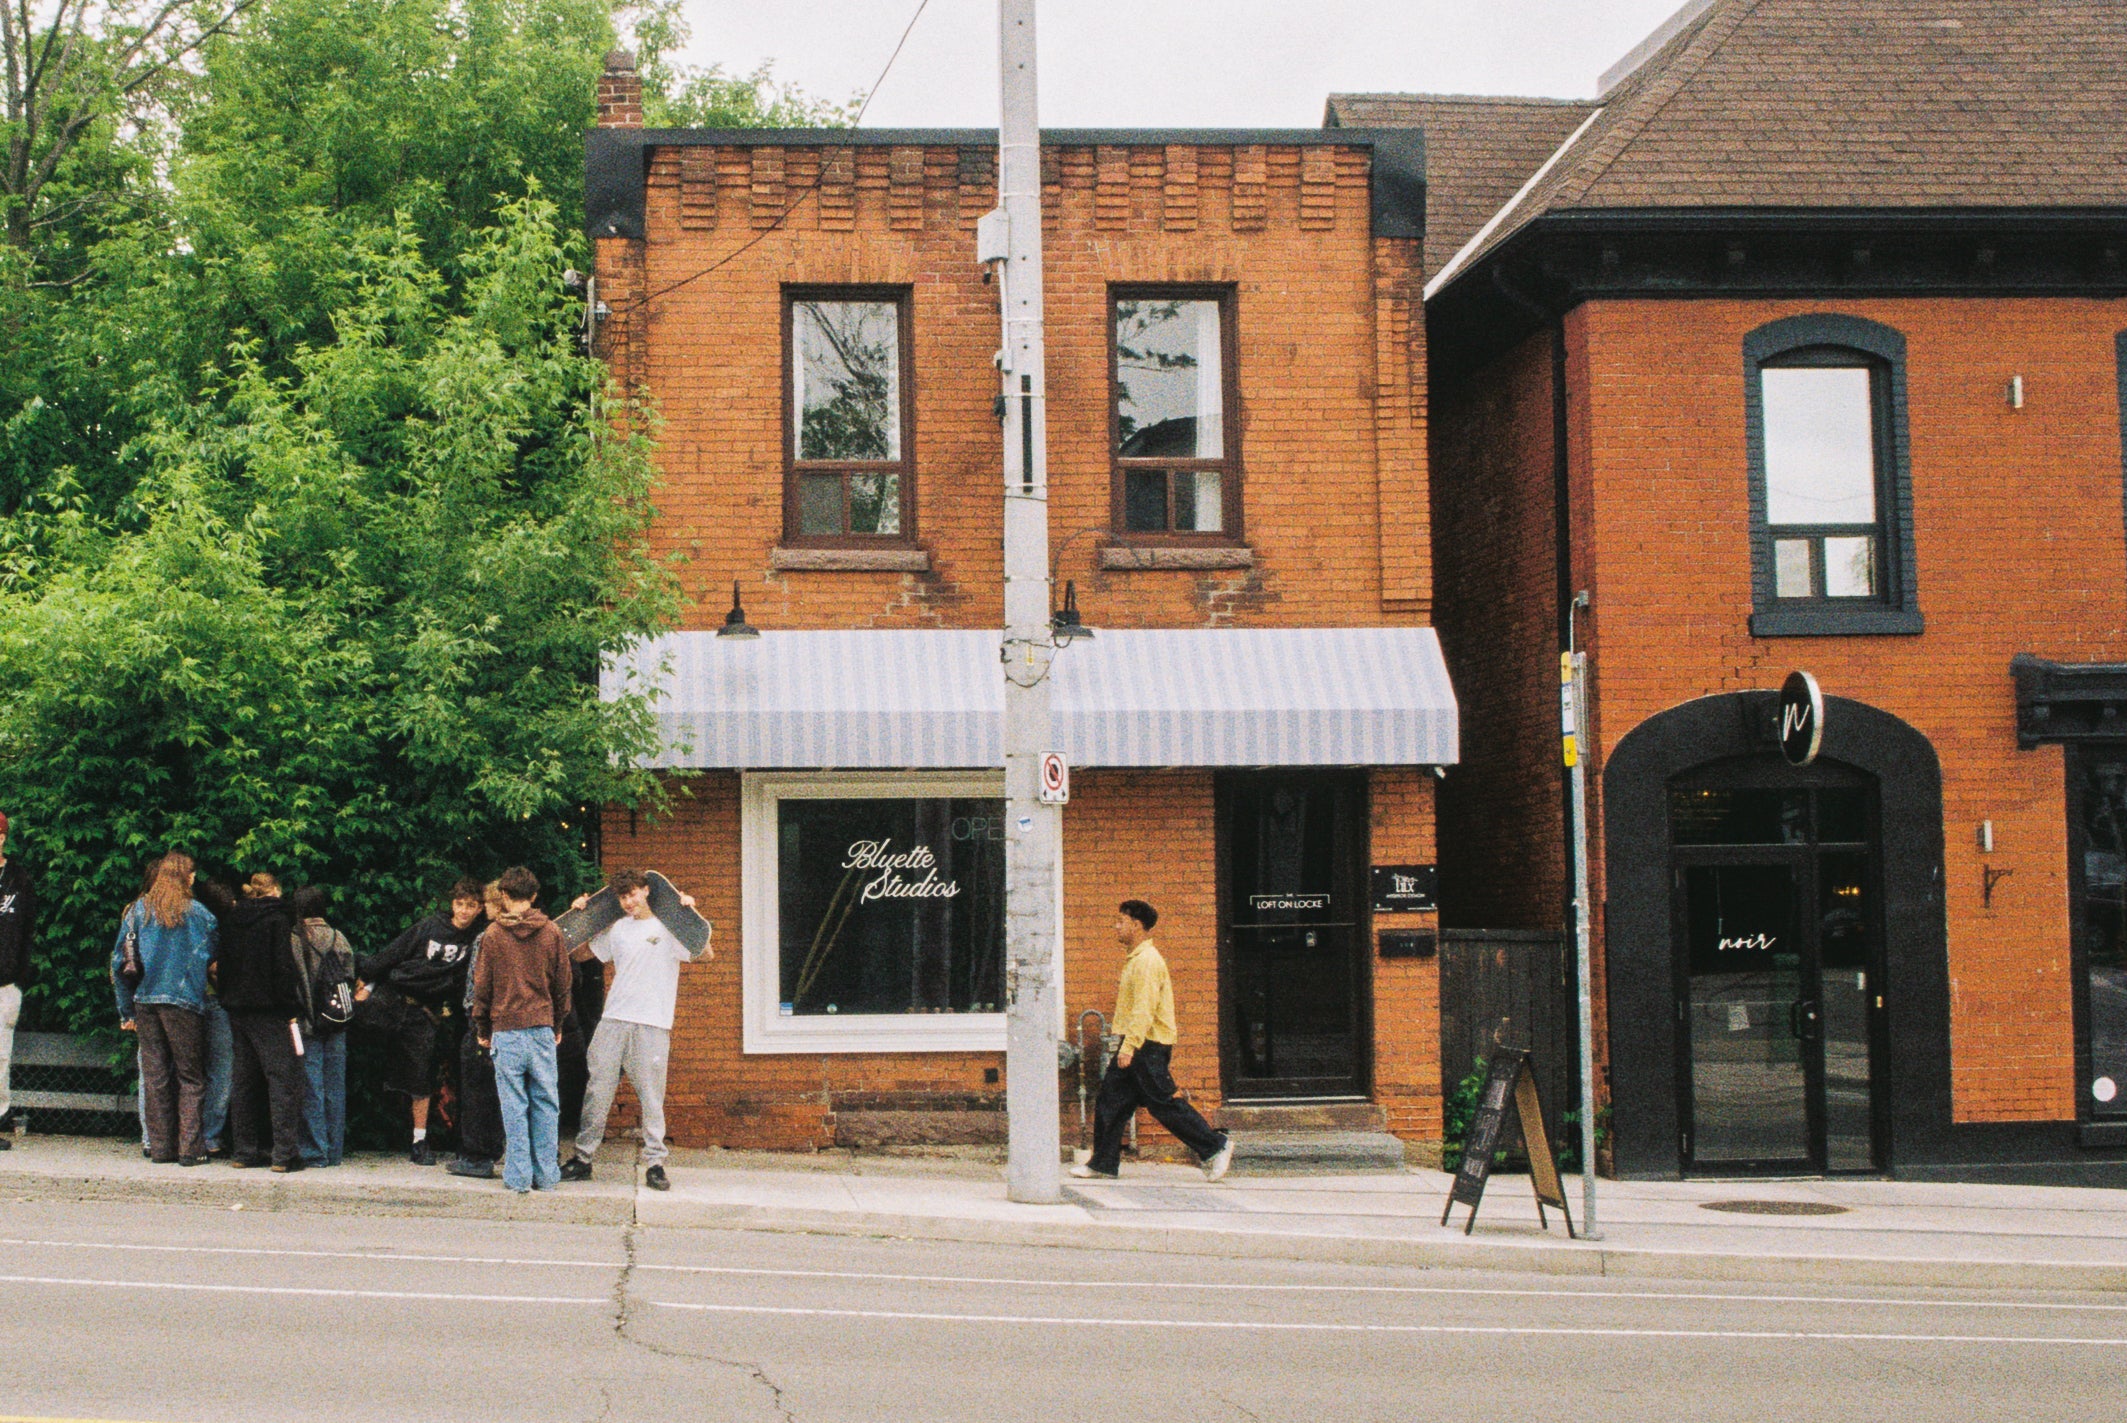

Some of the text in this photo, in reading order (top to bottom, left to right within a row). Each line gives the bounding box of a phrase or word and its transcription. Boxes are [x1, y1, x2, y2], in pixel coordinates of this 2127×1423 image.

[951, 816, 1007, 841] OPE
[860, 867, 961, 905] Studios
[1256, 900, 1324, 910] LOFT ON LOCKE
[1718, 933, 1777, 950] noir
